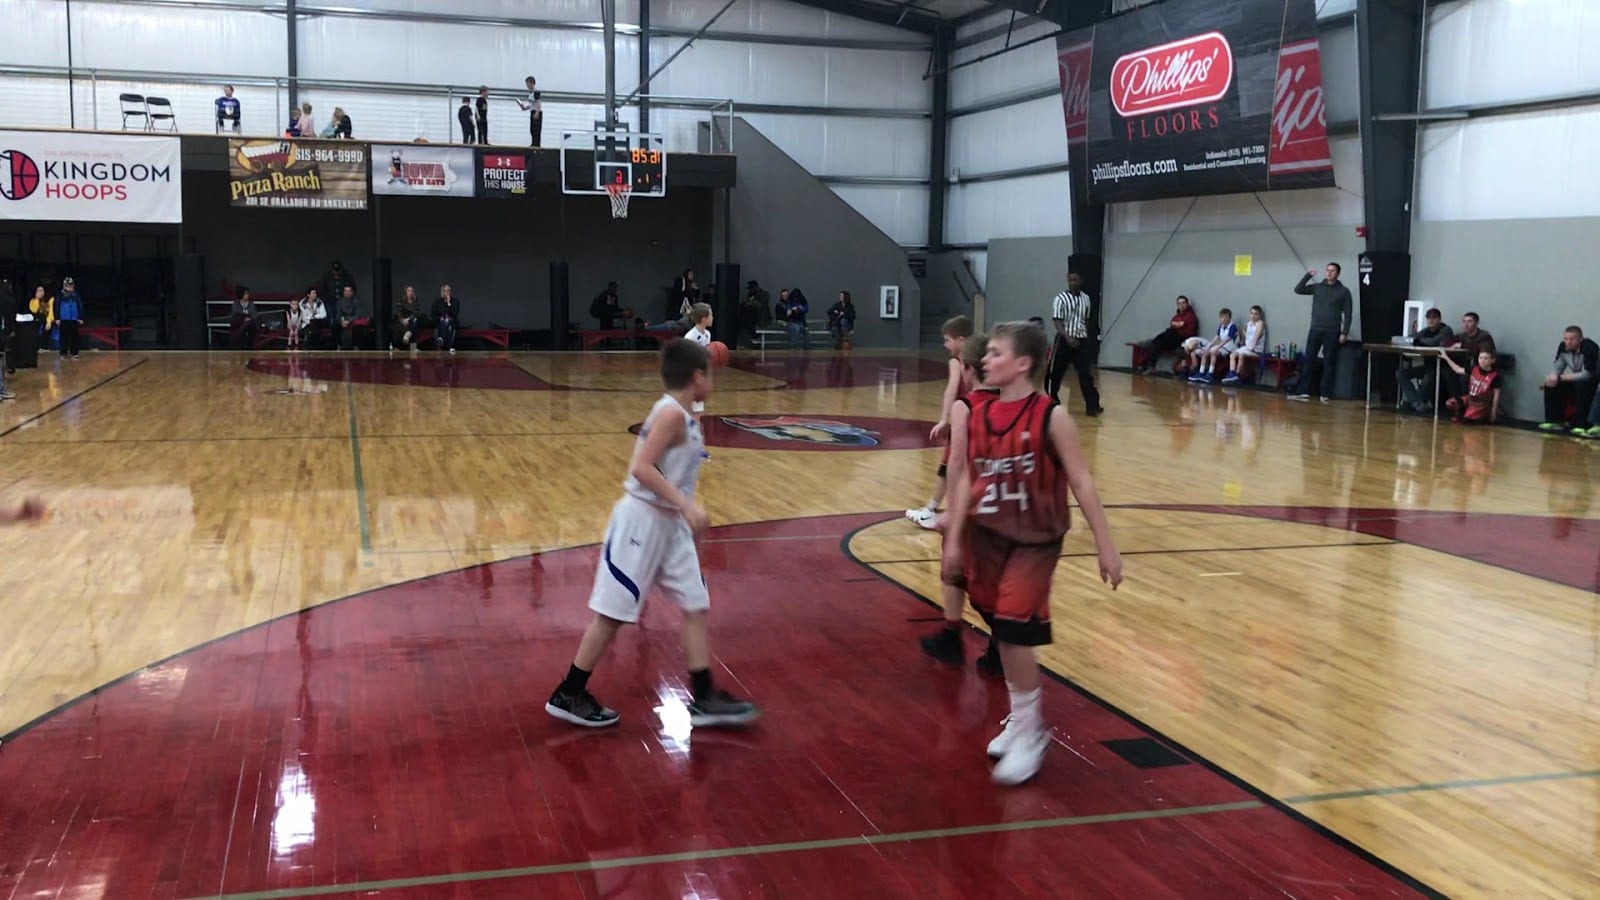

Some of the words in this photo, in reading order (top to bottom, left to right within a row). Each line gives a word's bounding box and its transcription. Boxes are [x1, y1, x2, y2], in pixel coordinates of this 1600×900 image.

[1120, 47, 1219, 109] Phillips'
[1126, 106, 1219, 141] FLOORS
[44, 160, 170, 182] KINGDOM
[483, 168, 526, 180] PROTECT
[1092, 159, 1178, 185] phillipsfloors.com
[46, 183, 128, 201] HOOPS
[230, 178, 272, 200] Pizza
[271, 170, 321, 191] Ranch
[484, 180, 500, 189] THIS
[501, 180, 526, 189] HOUSE
[1363, 273, 1370, 286] 4
[976, 481, 1029, 514] 24
